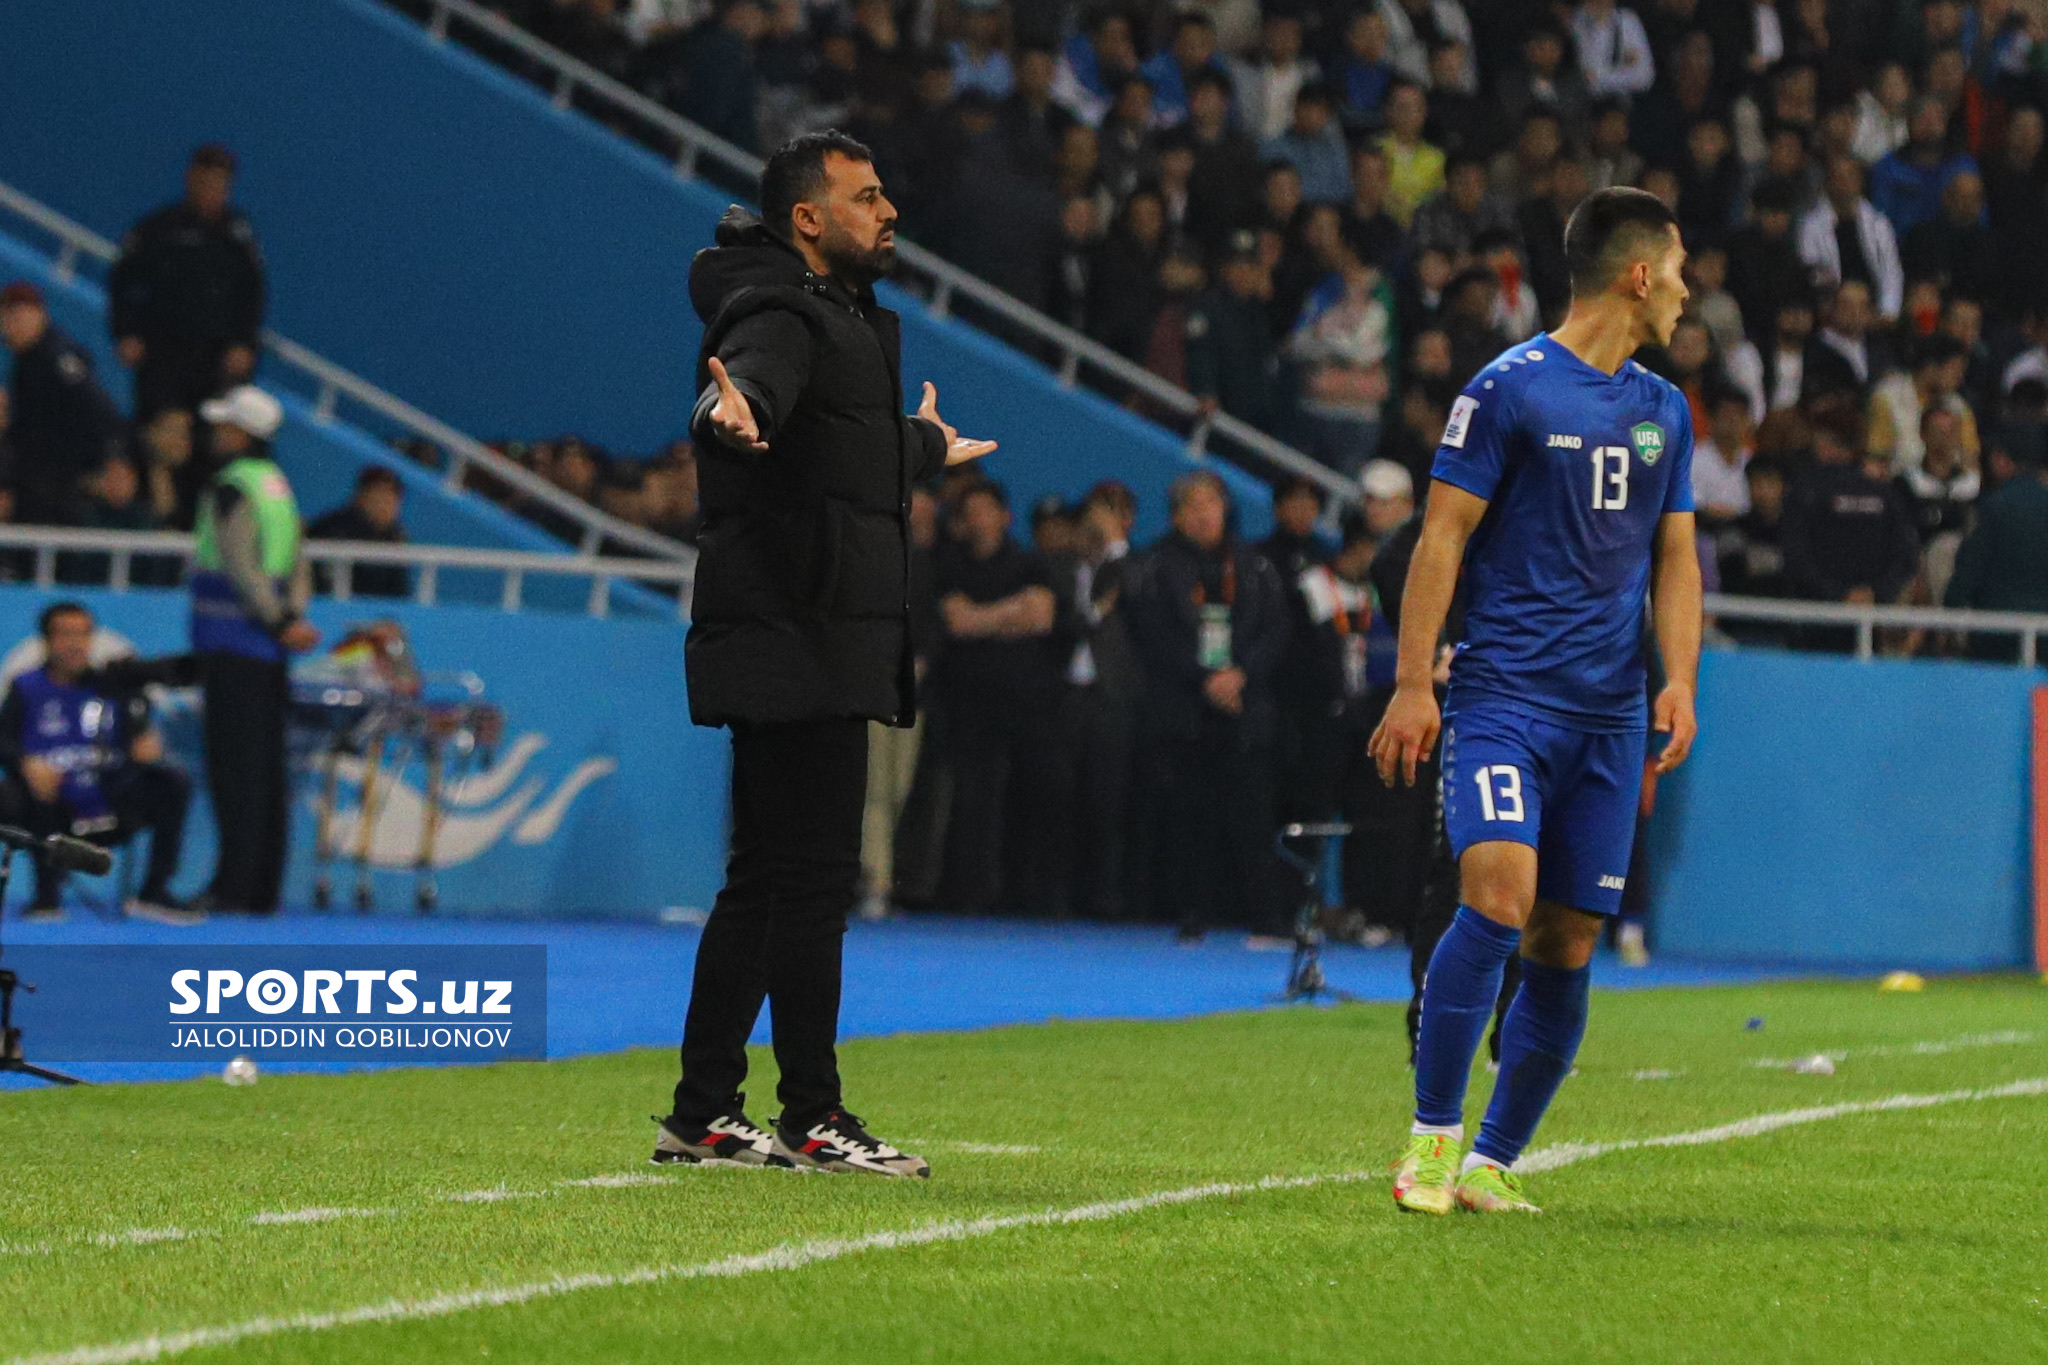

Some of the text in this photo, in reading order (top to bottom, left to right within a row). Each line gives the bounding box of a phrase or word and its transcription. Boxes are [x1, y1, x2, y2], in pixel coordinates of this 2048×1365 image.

[1546, 434, 1583, 449] JAKO
[1636, 430, 1661, 447] UFA
[1591, 446, 1630, 510] 13
[1474, 764, 1525, 823] 13
[1597, 874, 1626, 890] JAK
